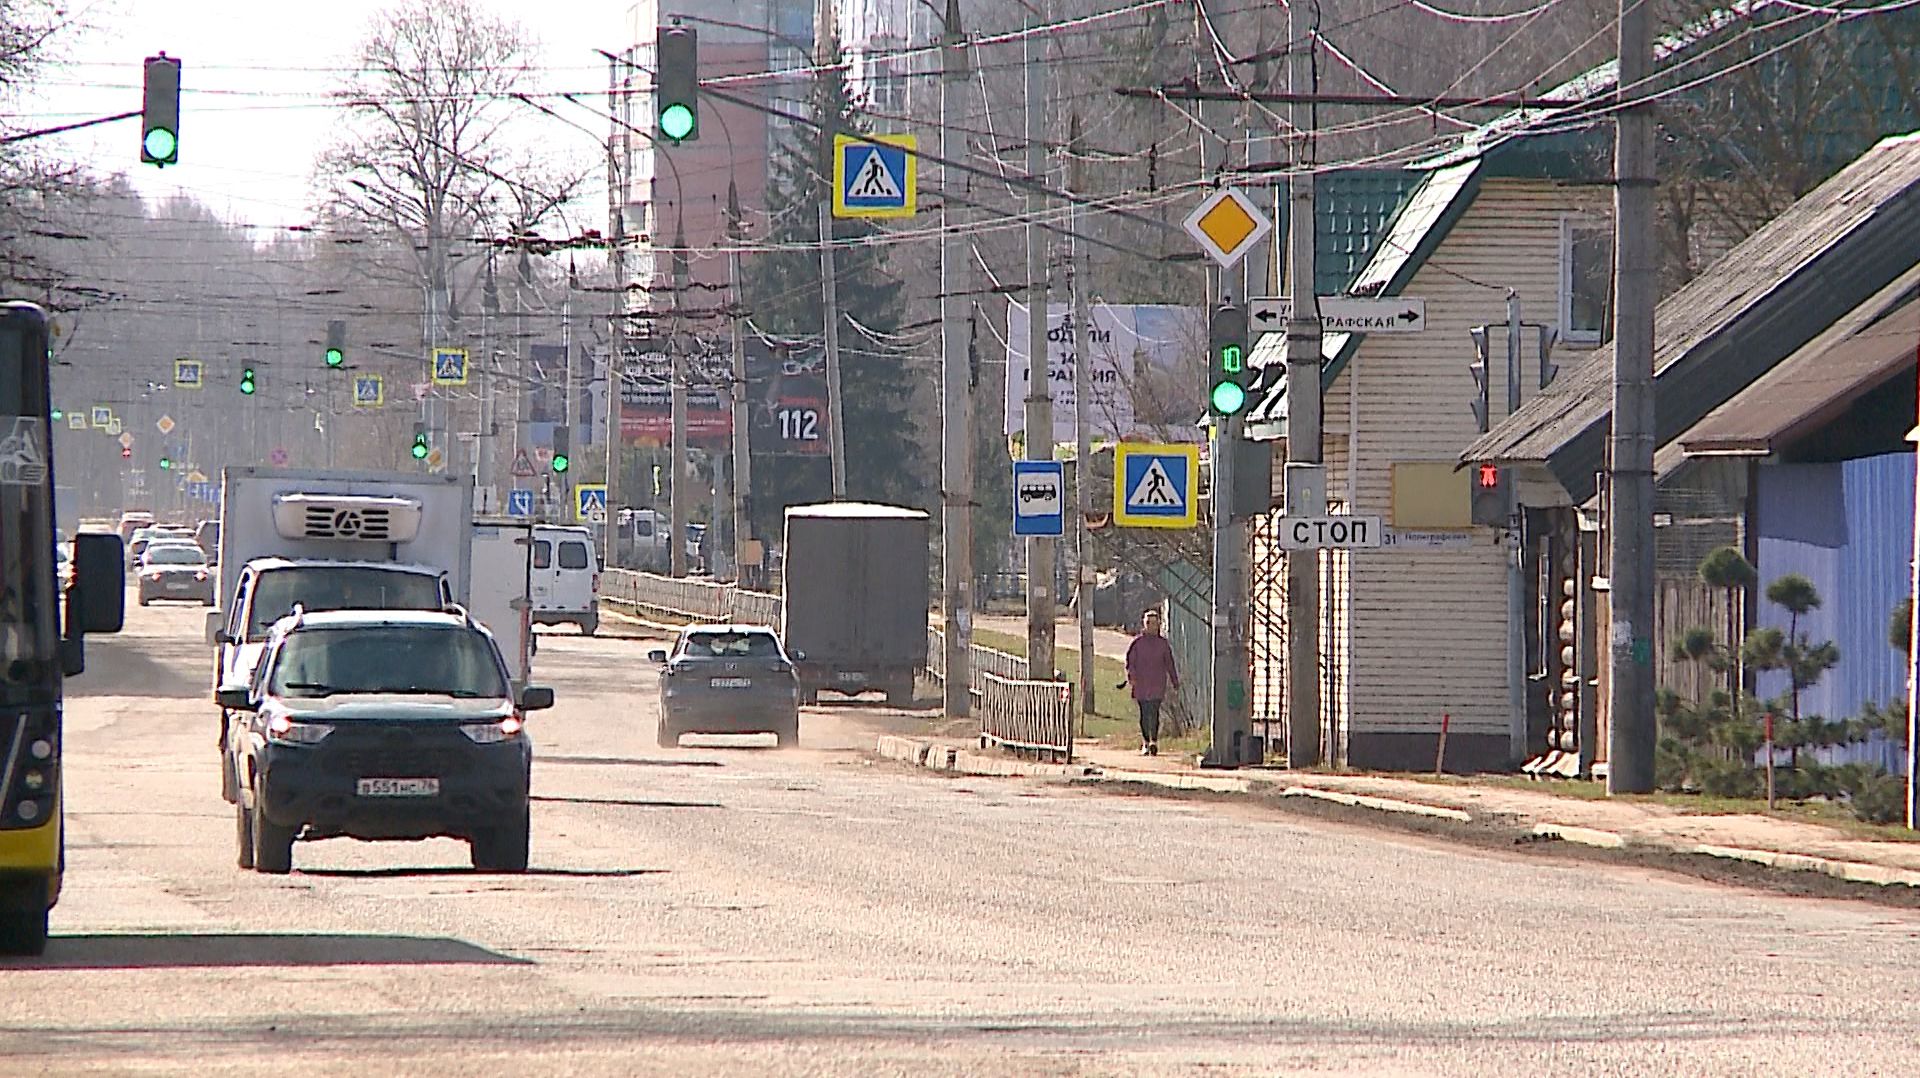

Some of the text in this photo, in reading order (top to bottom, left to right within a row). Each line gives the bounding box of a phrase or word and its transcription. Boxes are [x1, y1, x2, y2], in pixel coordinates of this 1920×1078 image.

[1280, 316, 1395, 327] ПРАФСКАЯ
[1223, 346, 1241, 372] 10
[779, 409, 819, 439] 112
[1293, 520, 1367, 543] СТОП
